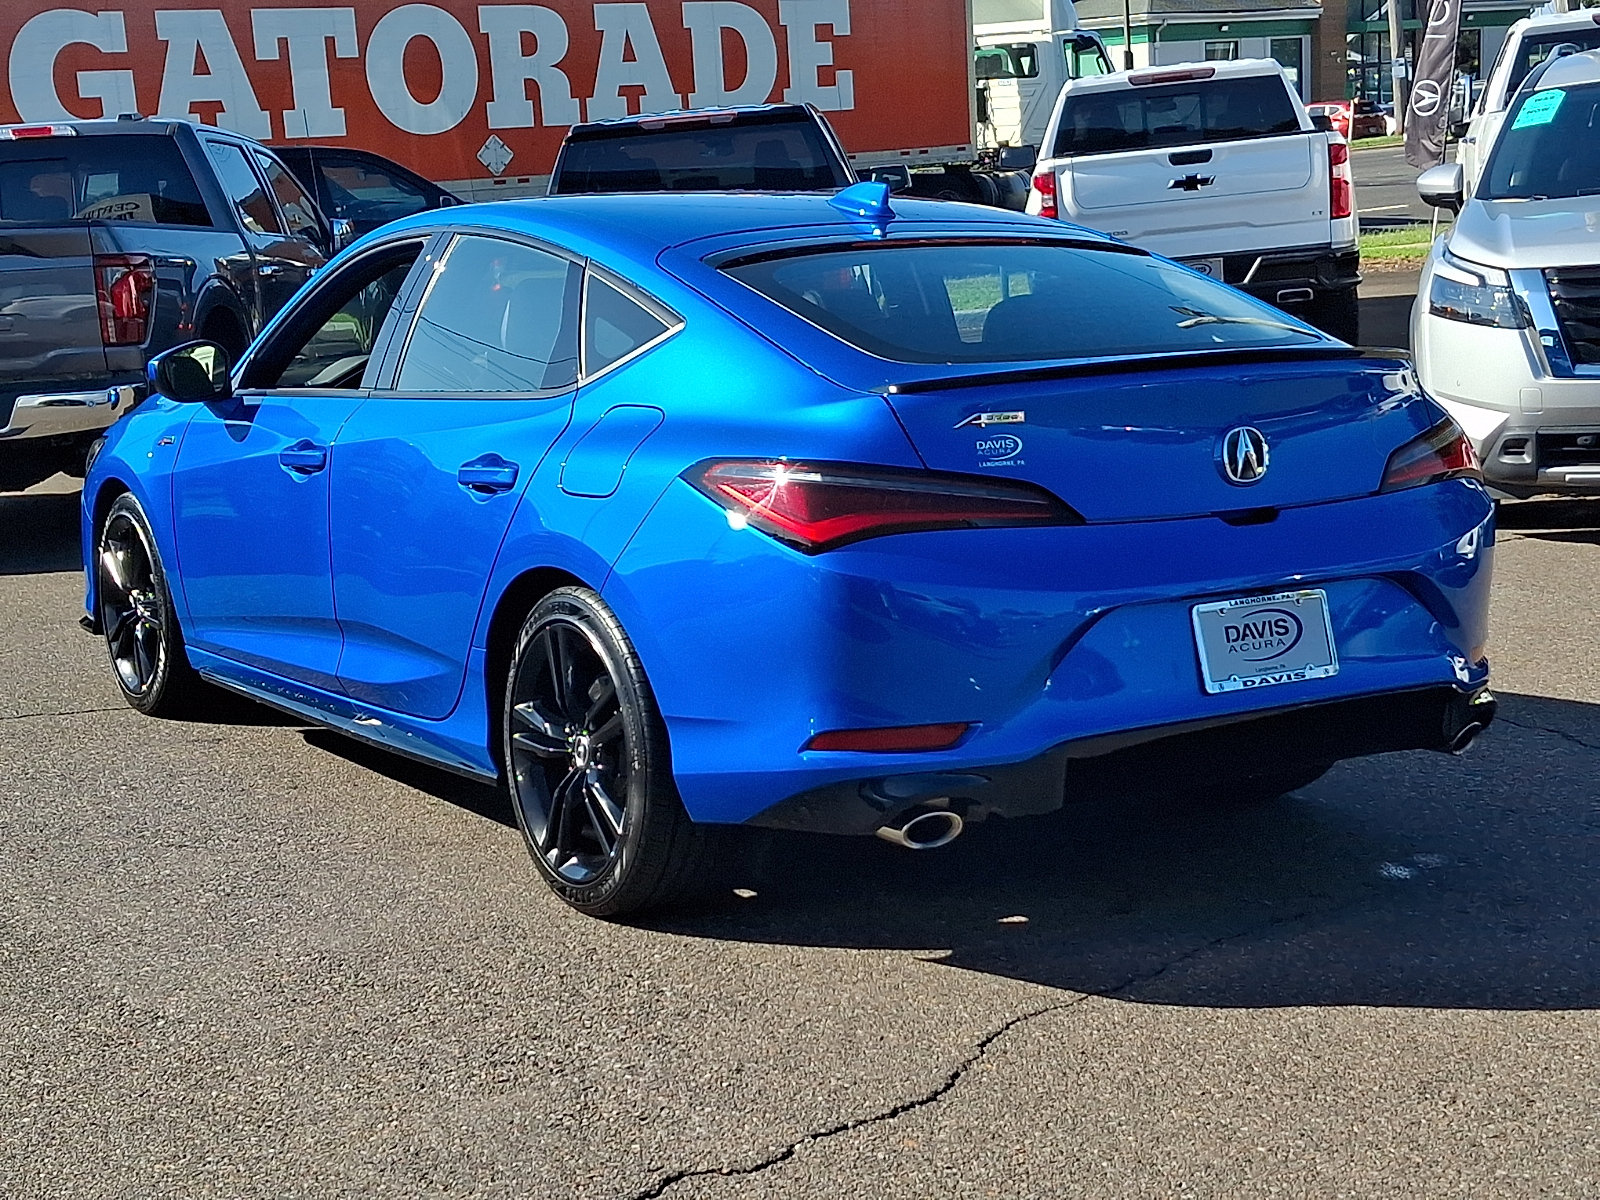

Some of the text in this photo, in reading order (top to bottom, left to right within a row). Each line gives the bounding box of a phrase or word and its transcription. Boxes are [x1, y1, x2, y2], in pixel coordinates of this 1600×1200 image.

[8, 0, 855, 140] GATORADE
[976, 439, 1014, 450] DAVIS
[1224, 618, 1290, 643] DAVIS
[1228, 638, 1287, 654] ACURA
[1242, 671, 1307, 687] DAVIS
